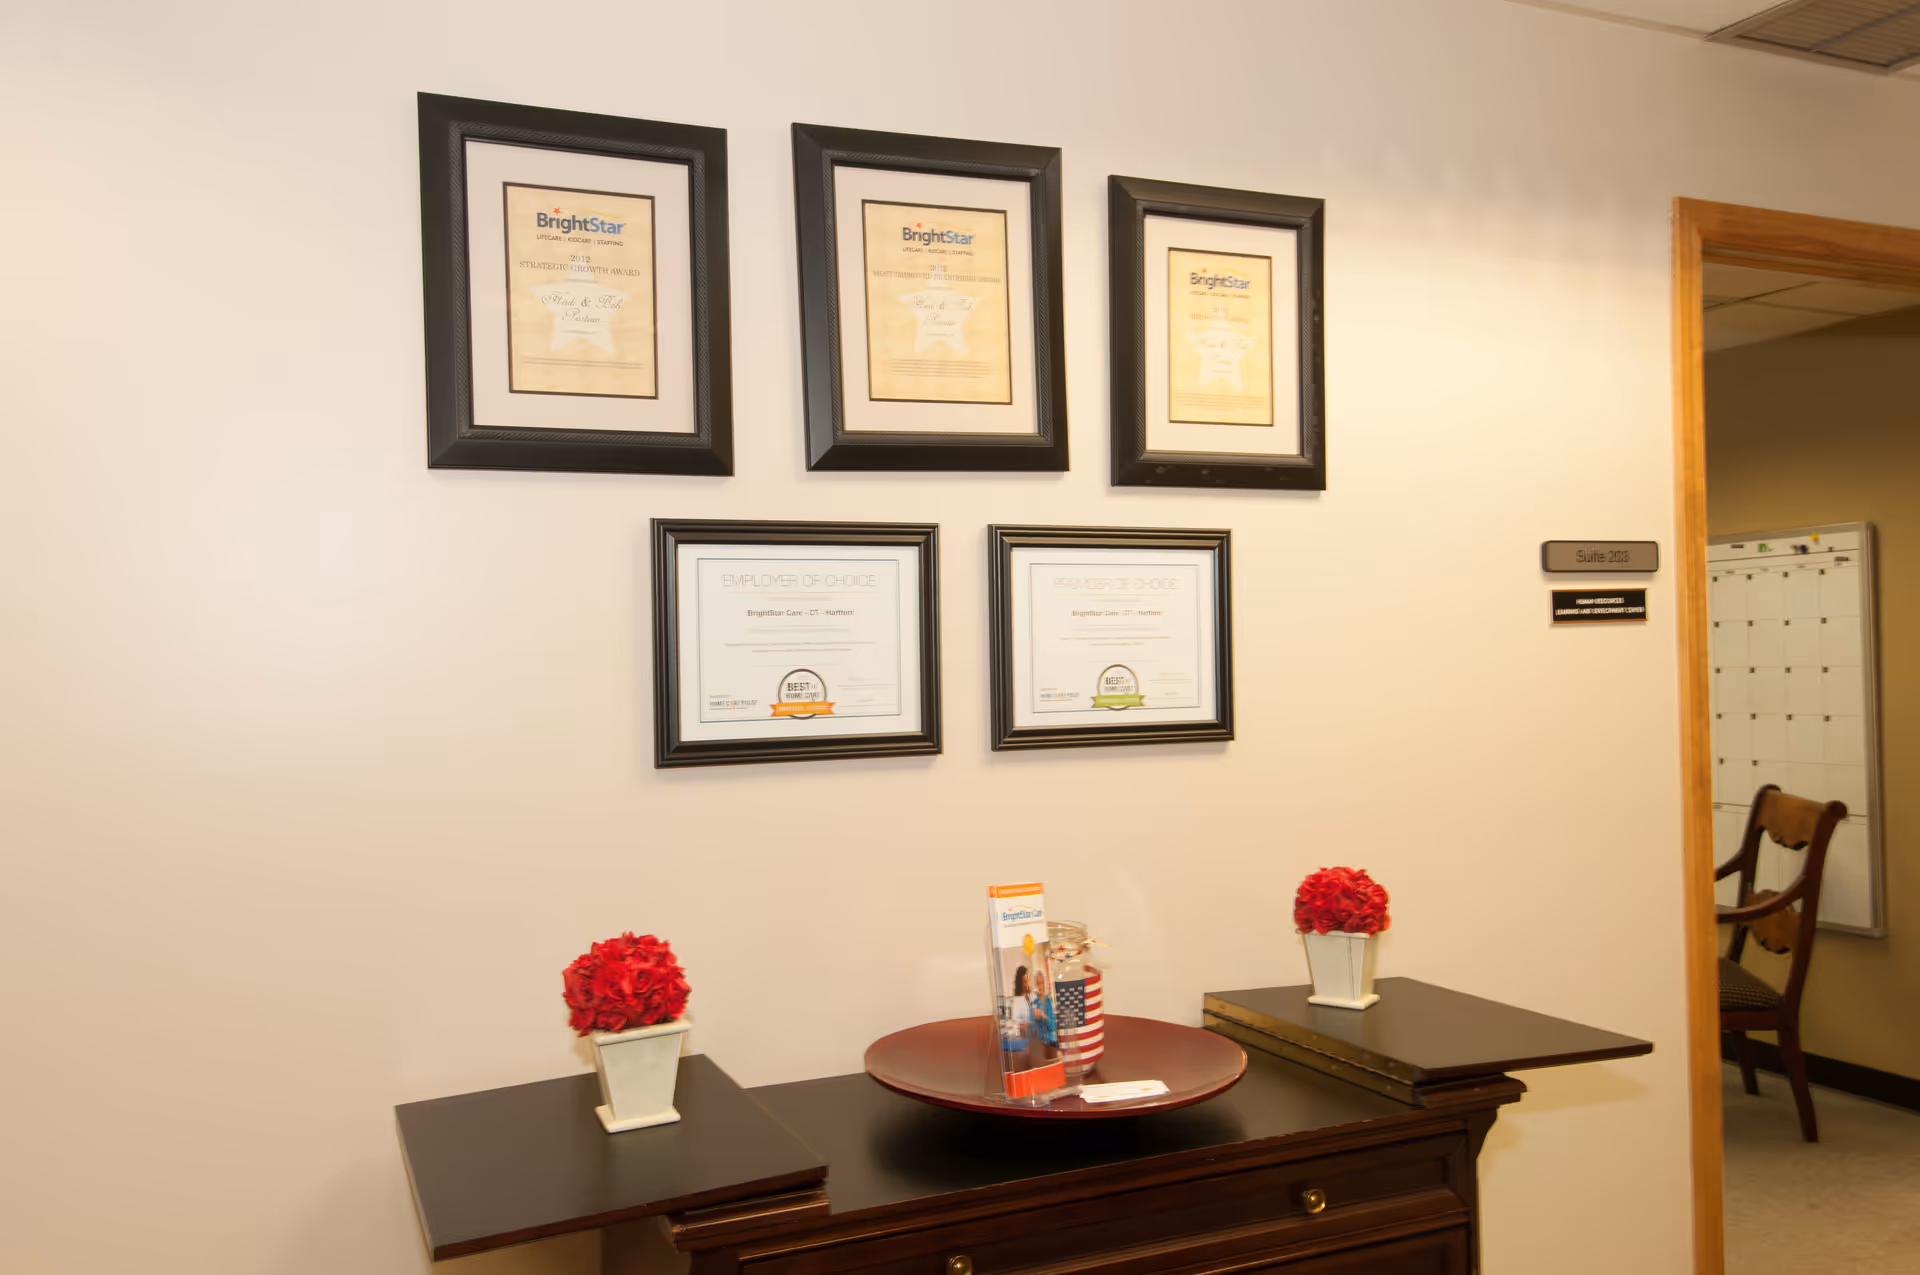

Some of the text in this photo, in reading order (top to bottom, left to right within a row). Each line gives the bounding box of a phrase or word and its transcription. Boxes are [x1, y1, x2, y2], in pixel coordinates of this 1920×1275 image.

[536, 212, 625, 235] BrightStar
[902, 226, 974, 246] BrightStar
[570, 254, 592, 263] 2012
[519, 260, 640, 277] STRATEGIC GROWTH AWARD
[1190, 272, 1251, 290] BrightStar
[580, 296, 592, 307] &
[1575, 549, 1606, 563] Suite
[722, 574, 878, 588] EMPLOYER OF CHOICE
[787, 682, 810, 692] BEST
